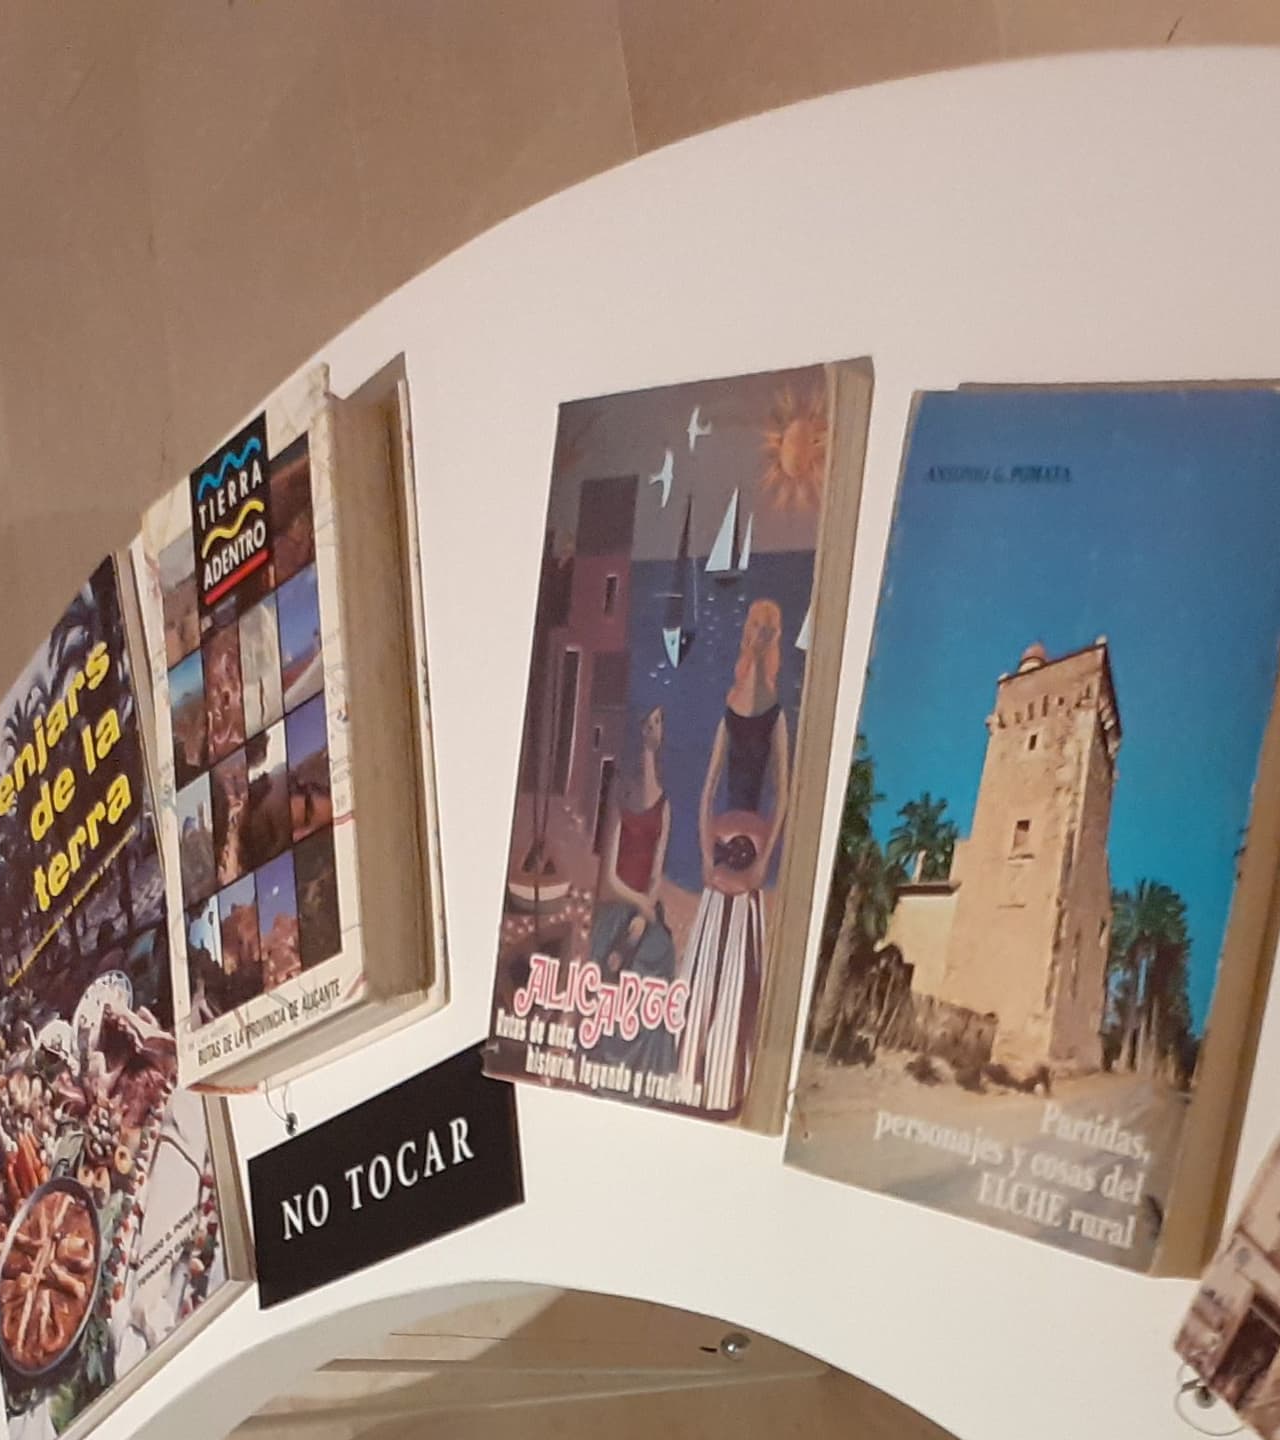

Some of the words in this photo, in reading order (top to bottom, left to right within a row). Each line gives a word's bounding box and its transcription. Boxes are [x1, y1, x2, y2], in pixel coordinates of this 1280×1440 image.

[198, 459, 262, 530] TIERRA
[203, 519, 266, 591] ADENTRO
[31, 767, 75, 841] de
[82, 708, 121, 775] la
[34, 773, 131, 911] terra
[198, 1036, 221, 1067] RUTAS
[223, 1033, 233, 1055] DE
[234, 1030, 244, 1048] LA
[246, 1012, 287, 1042] PROVINCIA
[288, 999, 299, 1022] DE
[302, 978, 341, 1011] ALICANTE
[495, 1007, 526, 1041] Rutas
[529, 1015, 545, 1044] de
[514, 953, 689, 1049] ALICANTE
[633, 1071, 643, 1099] y
[873, 1110, 1004, 1166] personajes
[1008, 1147, 1027, 1177] y
[1030, 1151, 1097, 1192] cosas
[1100, 1164, 1145, 1206] del
[1040, 1101, 1151, 1163] Partidas,
[281, 1184, 329, 1240] NO
[345, 1117, 474, 1210] TOCAR
[978, 1172, 1067, 1228] ELCHE
[1068, 1209, 1136, 1249] rural
